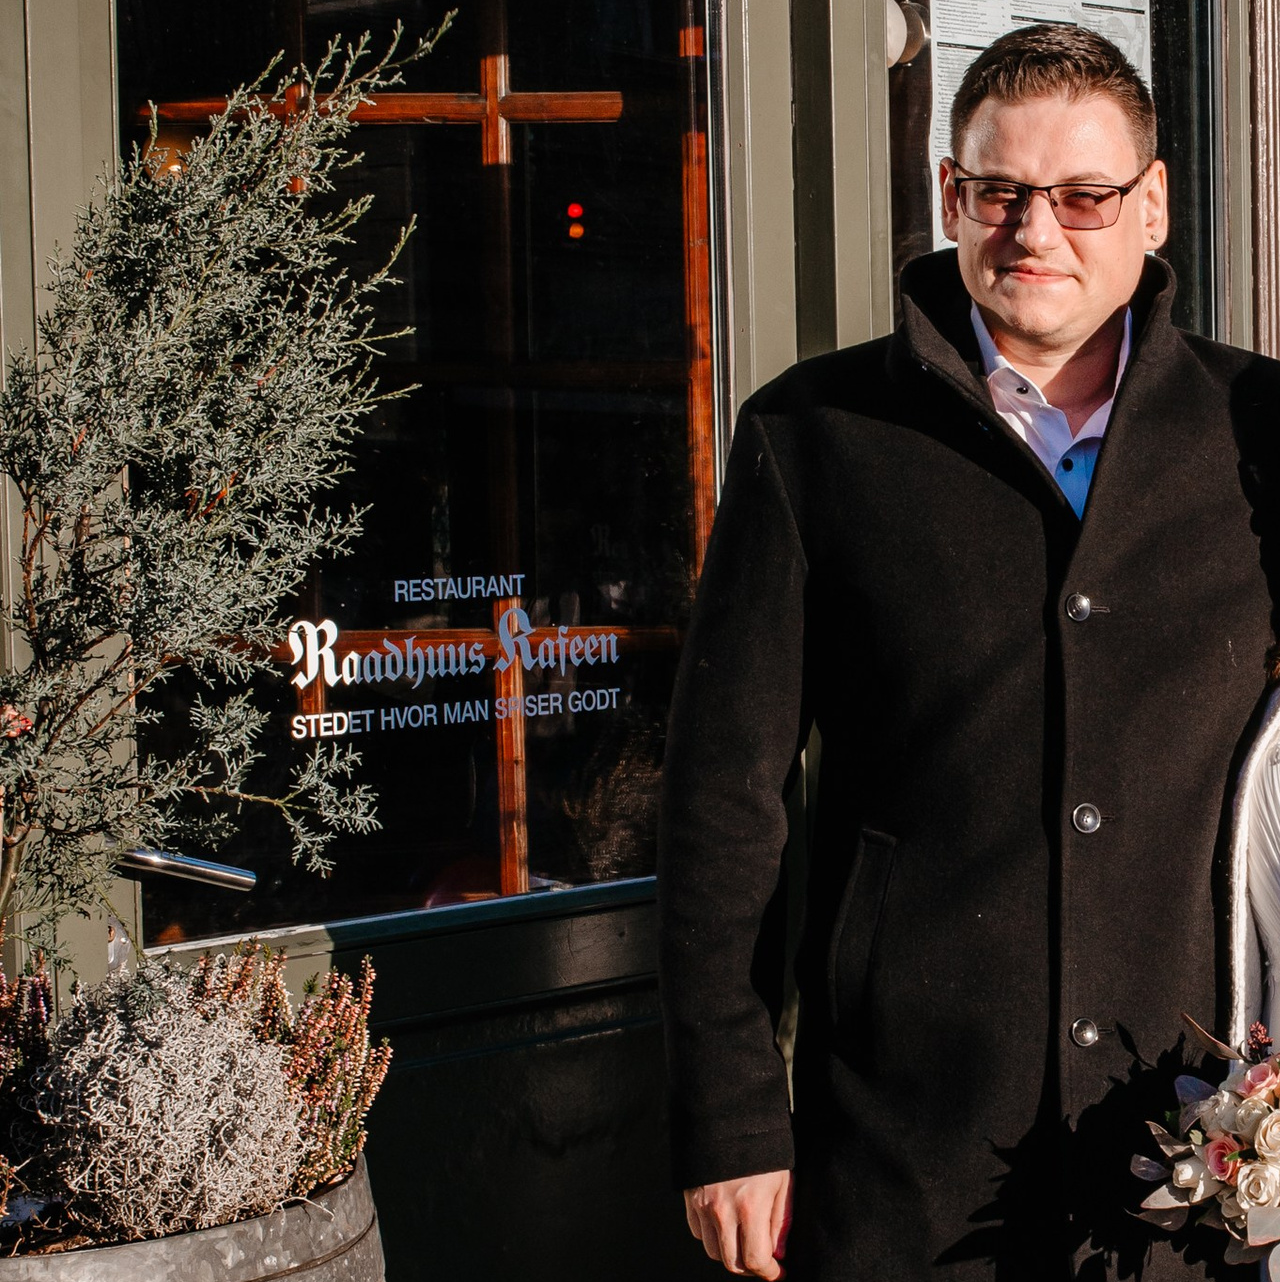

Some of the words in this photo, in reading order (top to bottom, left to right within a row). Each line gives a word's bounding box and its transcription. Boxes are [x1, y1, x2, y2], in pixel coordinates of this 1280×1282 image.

[394, 574, 525, 603] RESTAURANT
[287, 618, 487, 691] Raadhuus
[493, 607, 620, 677] Kafeen
[291, 709, 375, 739] STEDET
[381, 704, 437, 731] HVOR
[443, 699, 489, 724] MAN
[495, 692, 562, 720] SPISER
[568, 688, 620, 713] GODT
